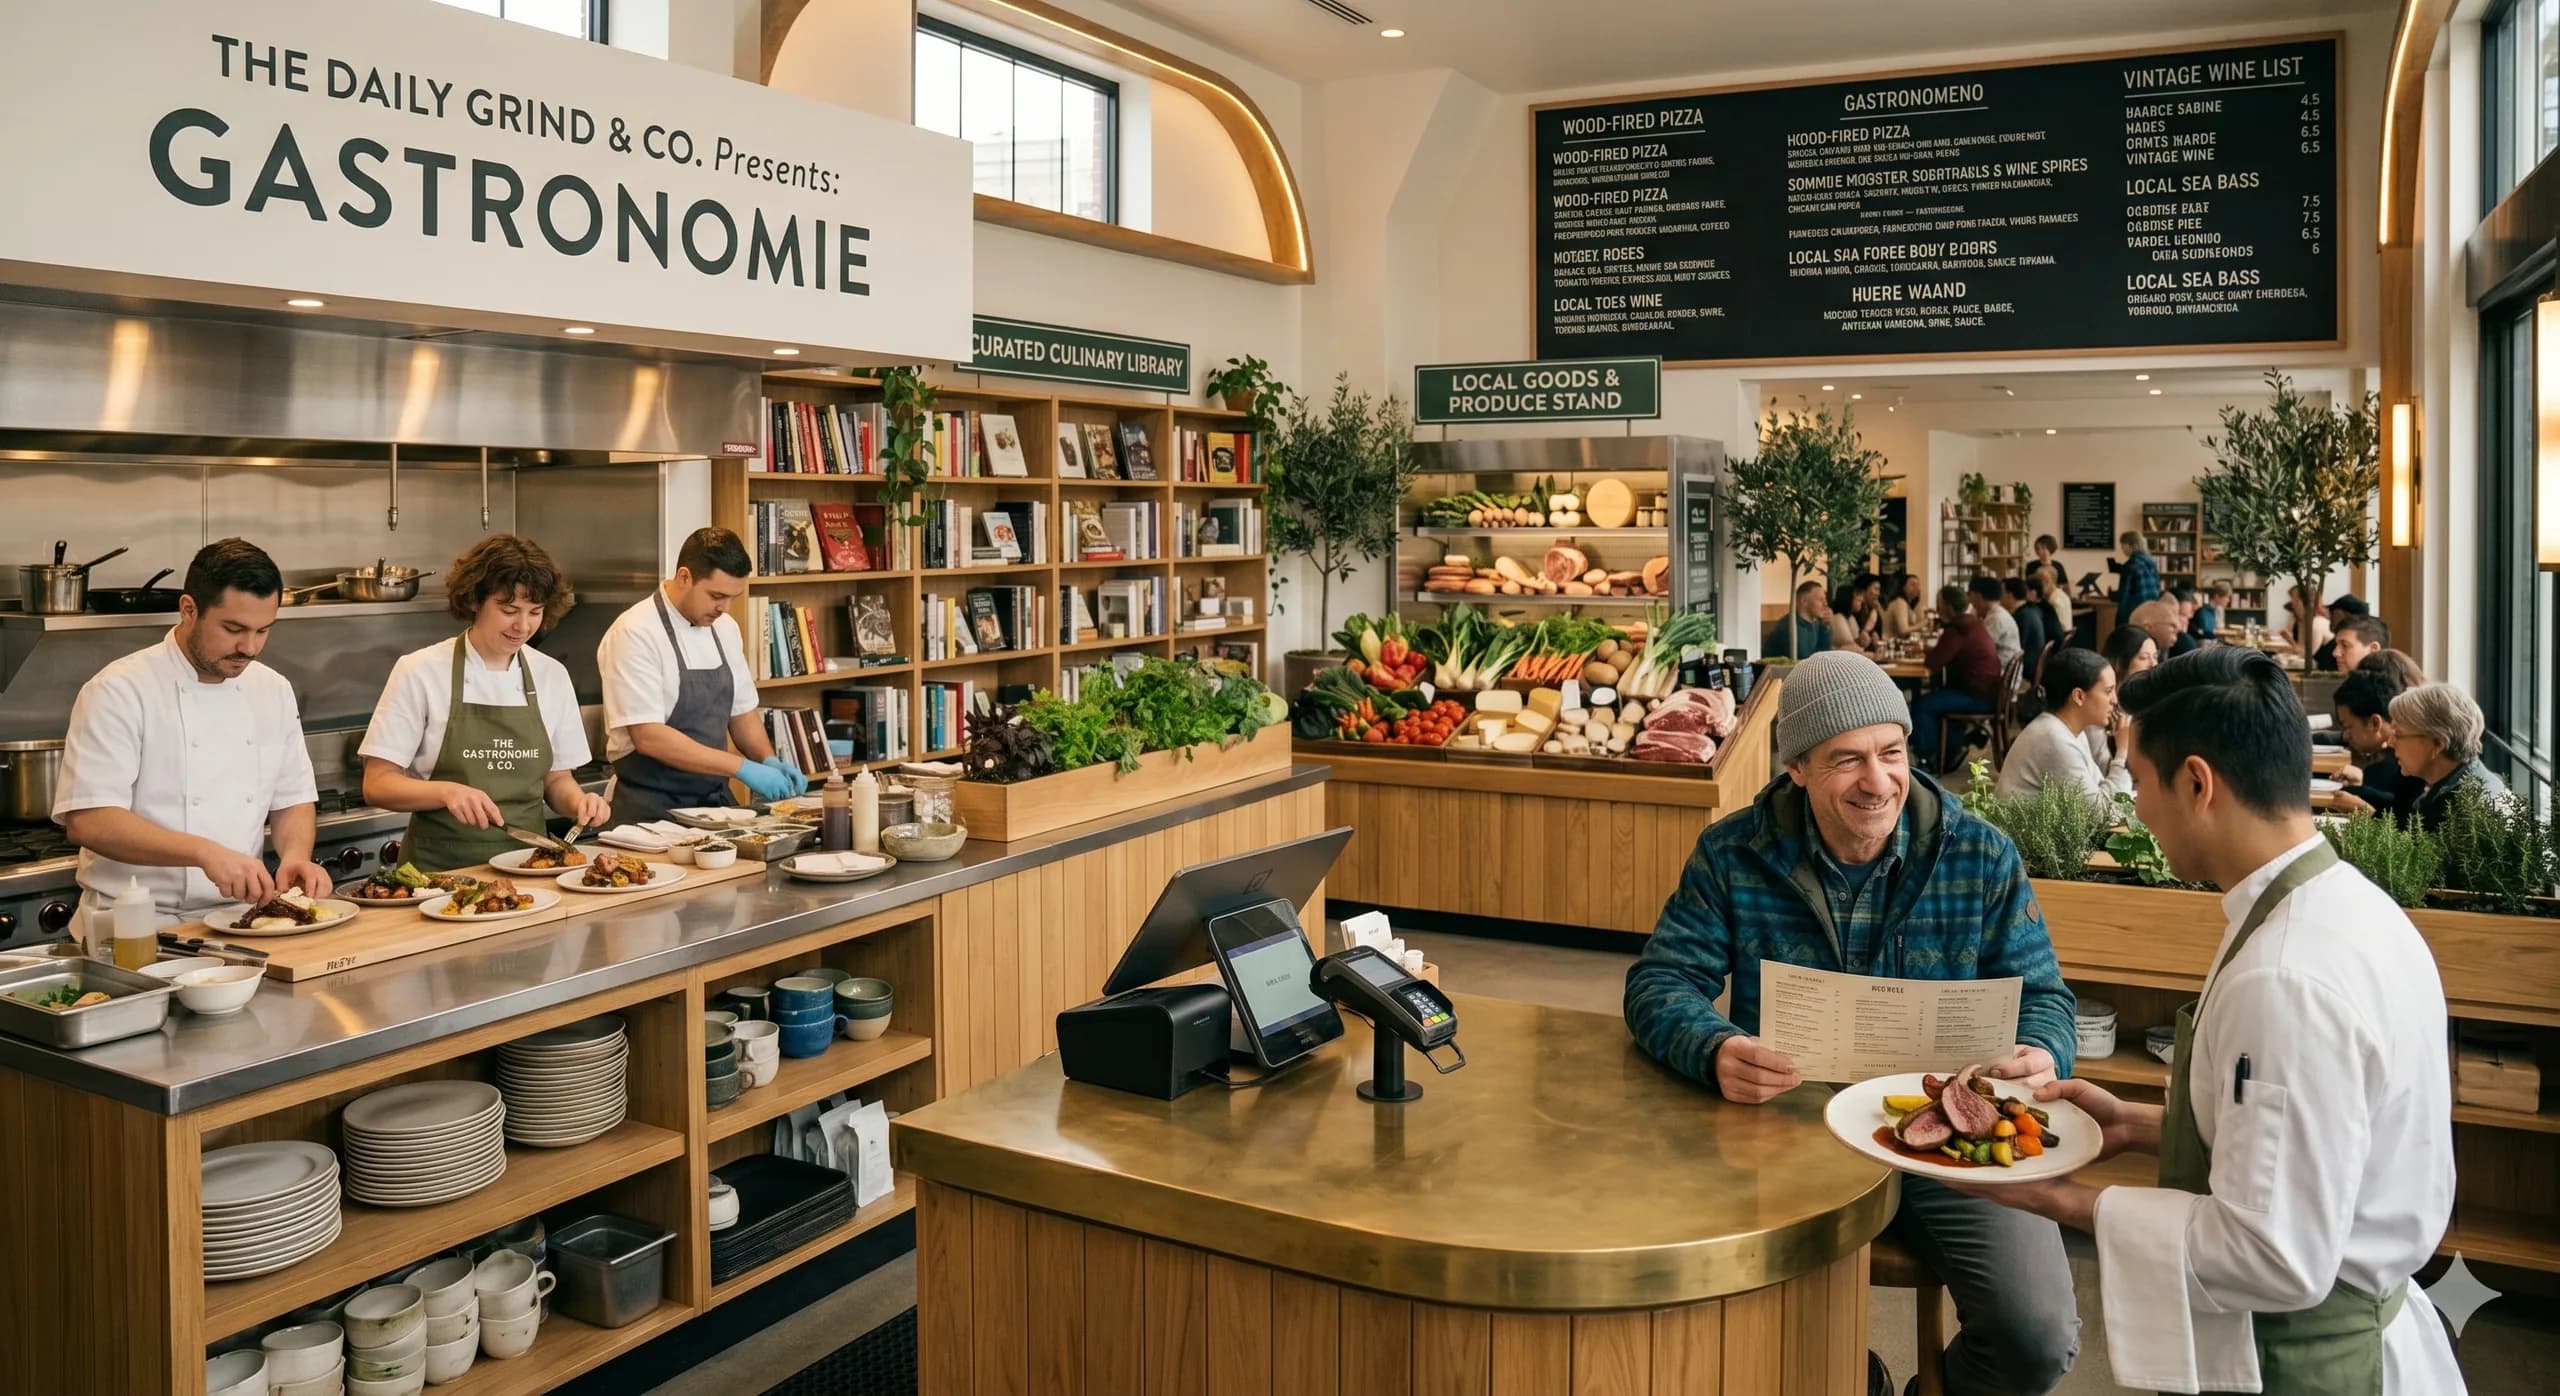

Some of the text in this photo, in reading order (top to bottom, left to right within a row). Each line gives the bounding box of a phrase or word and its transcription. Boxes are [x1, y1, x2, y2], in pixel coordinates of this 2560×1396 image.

[2124, 56, 2303, 89] VINTAGE WINE LIST
[1845, 84, 1984, 112] GASTRONOMENO
[2301, 94, 2320, 106] 4.5
[212, 34, 841, 195] THE DAILY GRIND & CO. Presents:
[2178, 100, 2223, 115] SABINE
[2301, 110, 2320, 122] 4.5
[1563, 109, 1703, 135] WOOD-FIRED PIZZA
[1873, 124, 1910, 140] PIZZA
[2302, 125, 2320, 138] 6.5
[1553, 144, 1668, 164] WOOD-FIRED PIZZA
[2126, 148, 2215, 165] VINTAGE WINE
[2302, 141, 2320, 154] 6.5
[2006, 161, 2038, 176] WINE
[2042, 158, 2088, 173] SPIRES
[2127, 172, 2259, 196] LOCAL SEA BASS
[149, 107, 870, 297] GASTRONOMIE
[1553, 188, 1668, 208] WOOD-FIRED PIZZA
[2302, 195, 2320, 208] 7.5
[2303, 211, 2320, 224] 7.5
[2302, 228, 2320, 240] 6.5
[1789, 250, 1830, 264] LOCAL
[1864, 245, 1906, 260] FOREE
[2312, 243, 2320, 254] 6
[2127, 269, 2260, 290] LOCAL SEA BASS
[1853, 282, 1966, 302] HUERE WAAND
[2196, 292, 2224, 301] SAUCE
[1554, 294, 1663, 312] LOCAL TOES WINE
[973, 333, 1183, 377] CURATED CULINARY LIBRARY
[1453, 369, 1619, 391] LOCAL GOODS &
[1449, 392, 1622, 413] PRODUCE STAND
[493, 739, 513, 748] THE
[463, 749, 539, 759] GASTRONOMIE
[487, 761, 515, 770] & CO.
